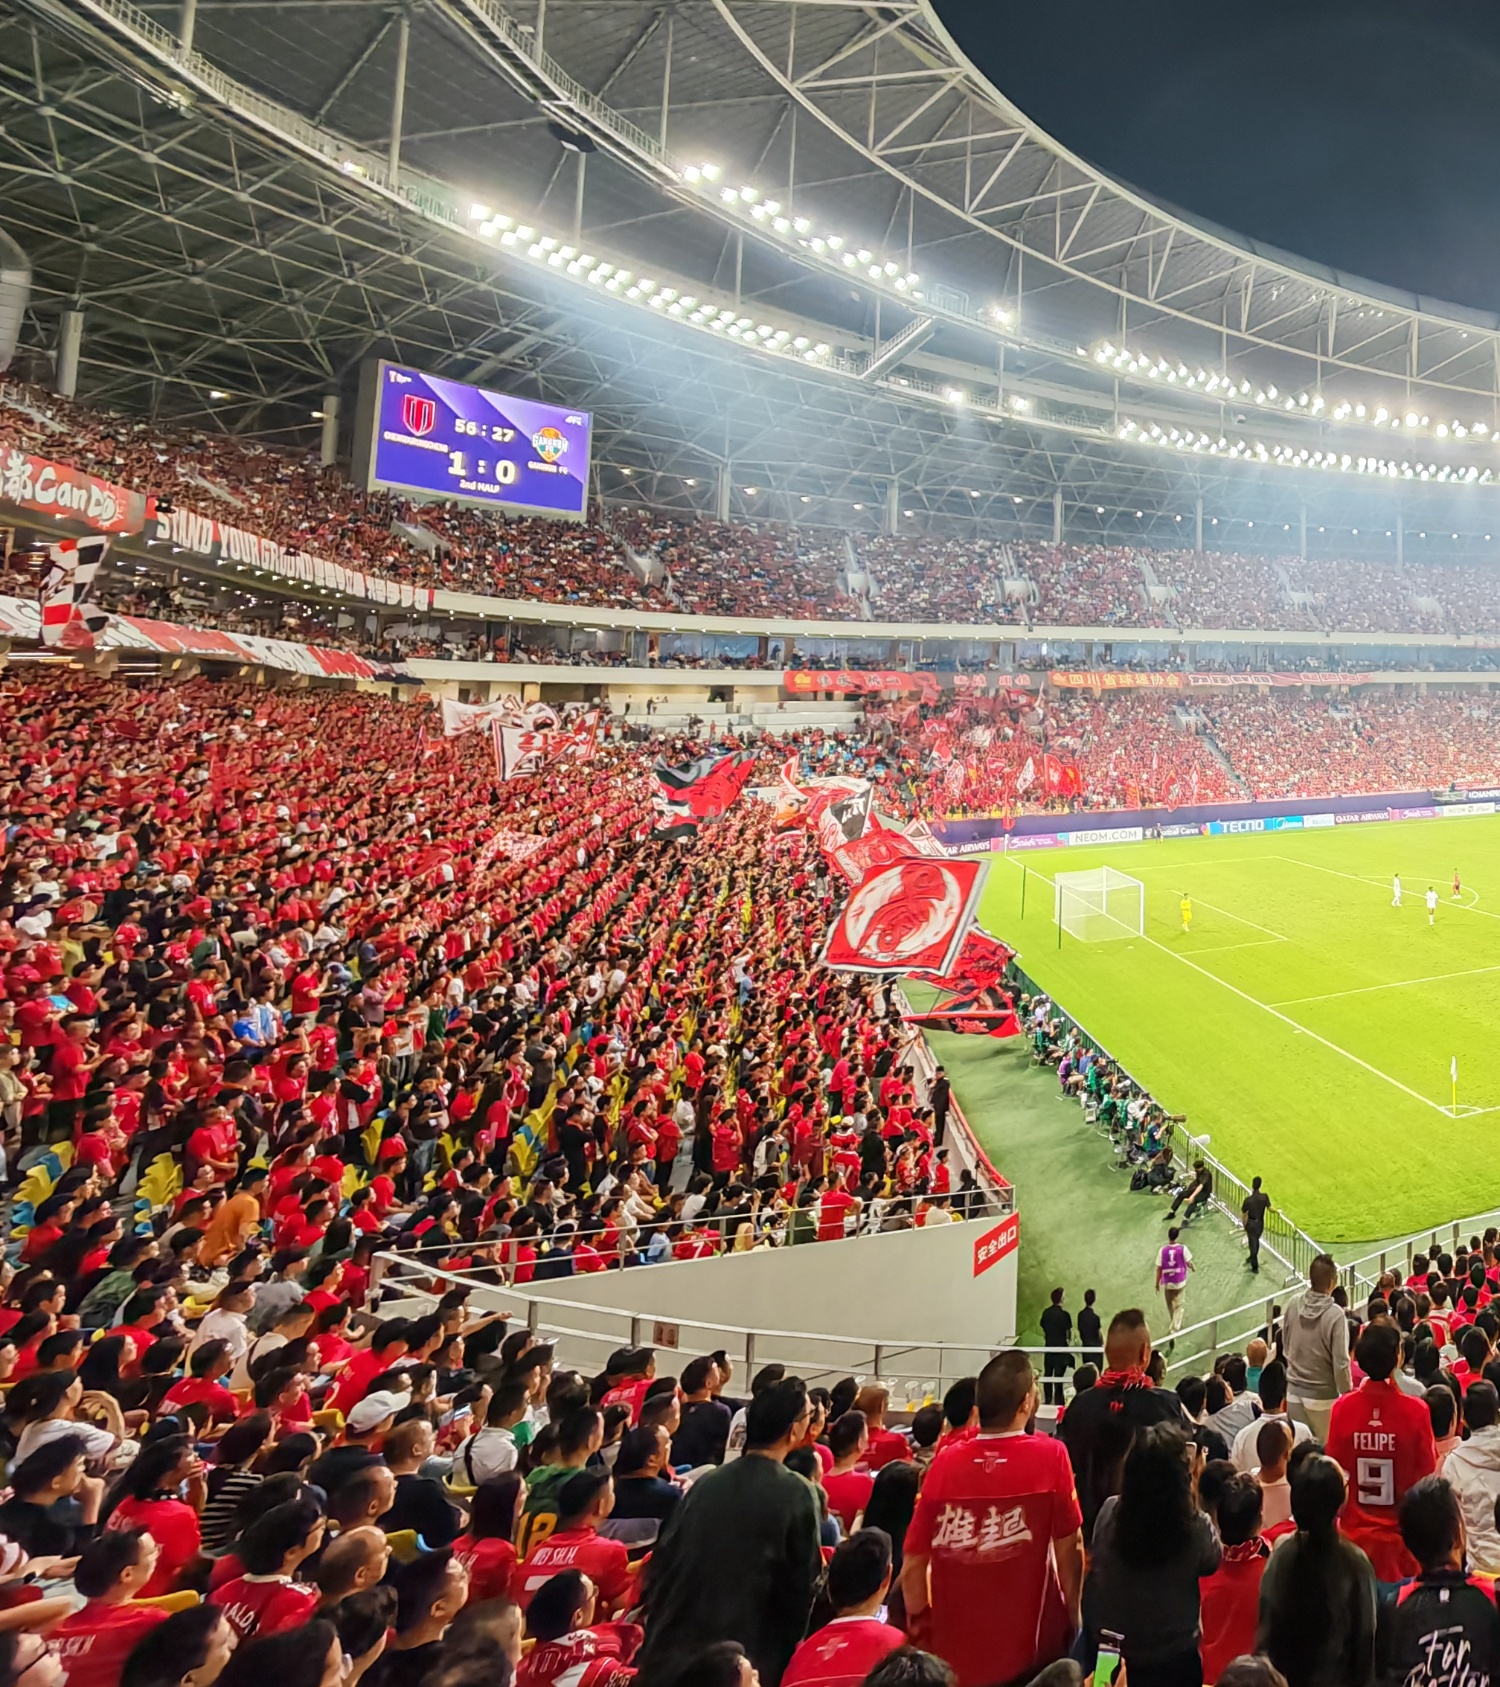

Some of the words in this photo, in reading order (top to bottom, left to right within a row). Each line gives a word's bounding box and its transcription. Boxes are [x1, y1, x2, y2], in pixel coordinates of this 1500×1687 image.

[455, 418, 477, 435] 56
[492, 426, 515, 443] 27
[448, 451, 467, 476] 1
[495, 459, 516, 485] 0
[218, 522, 260, 566] YOUR
[1222, 820, 1264, 833] TECNO
[1335, 814, 1360, 823] QATAR
[1360, 812, 1389, 822] AIRWAYS
[959, 840, 991, 853] AIRWAYS
[1075, 830, 1137, 843] NEOM.COM
[976, 1224, 1018, 1265] 安全出口
[1353, 1431, 1397, 1452] FELIPE
[1356, 1456, 1395, 1506] 9
[930, 1501, 1034, 1553] 雄起
[1418, 1625, 1472, 1677] For
